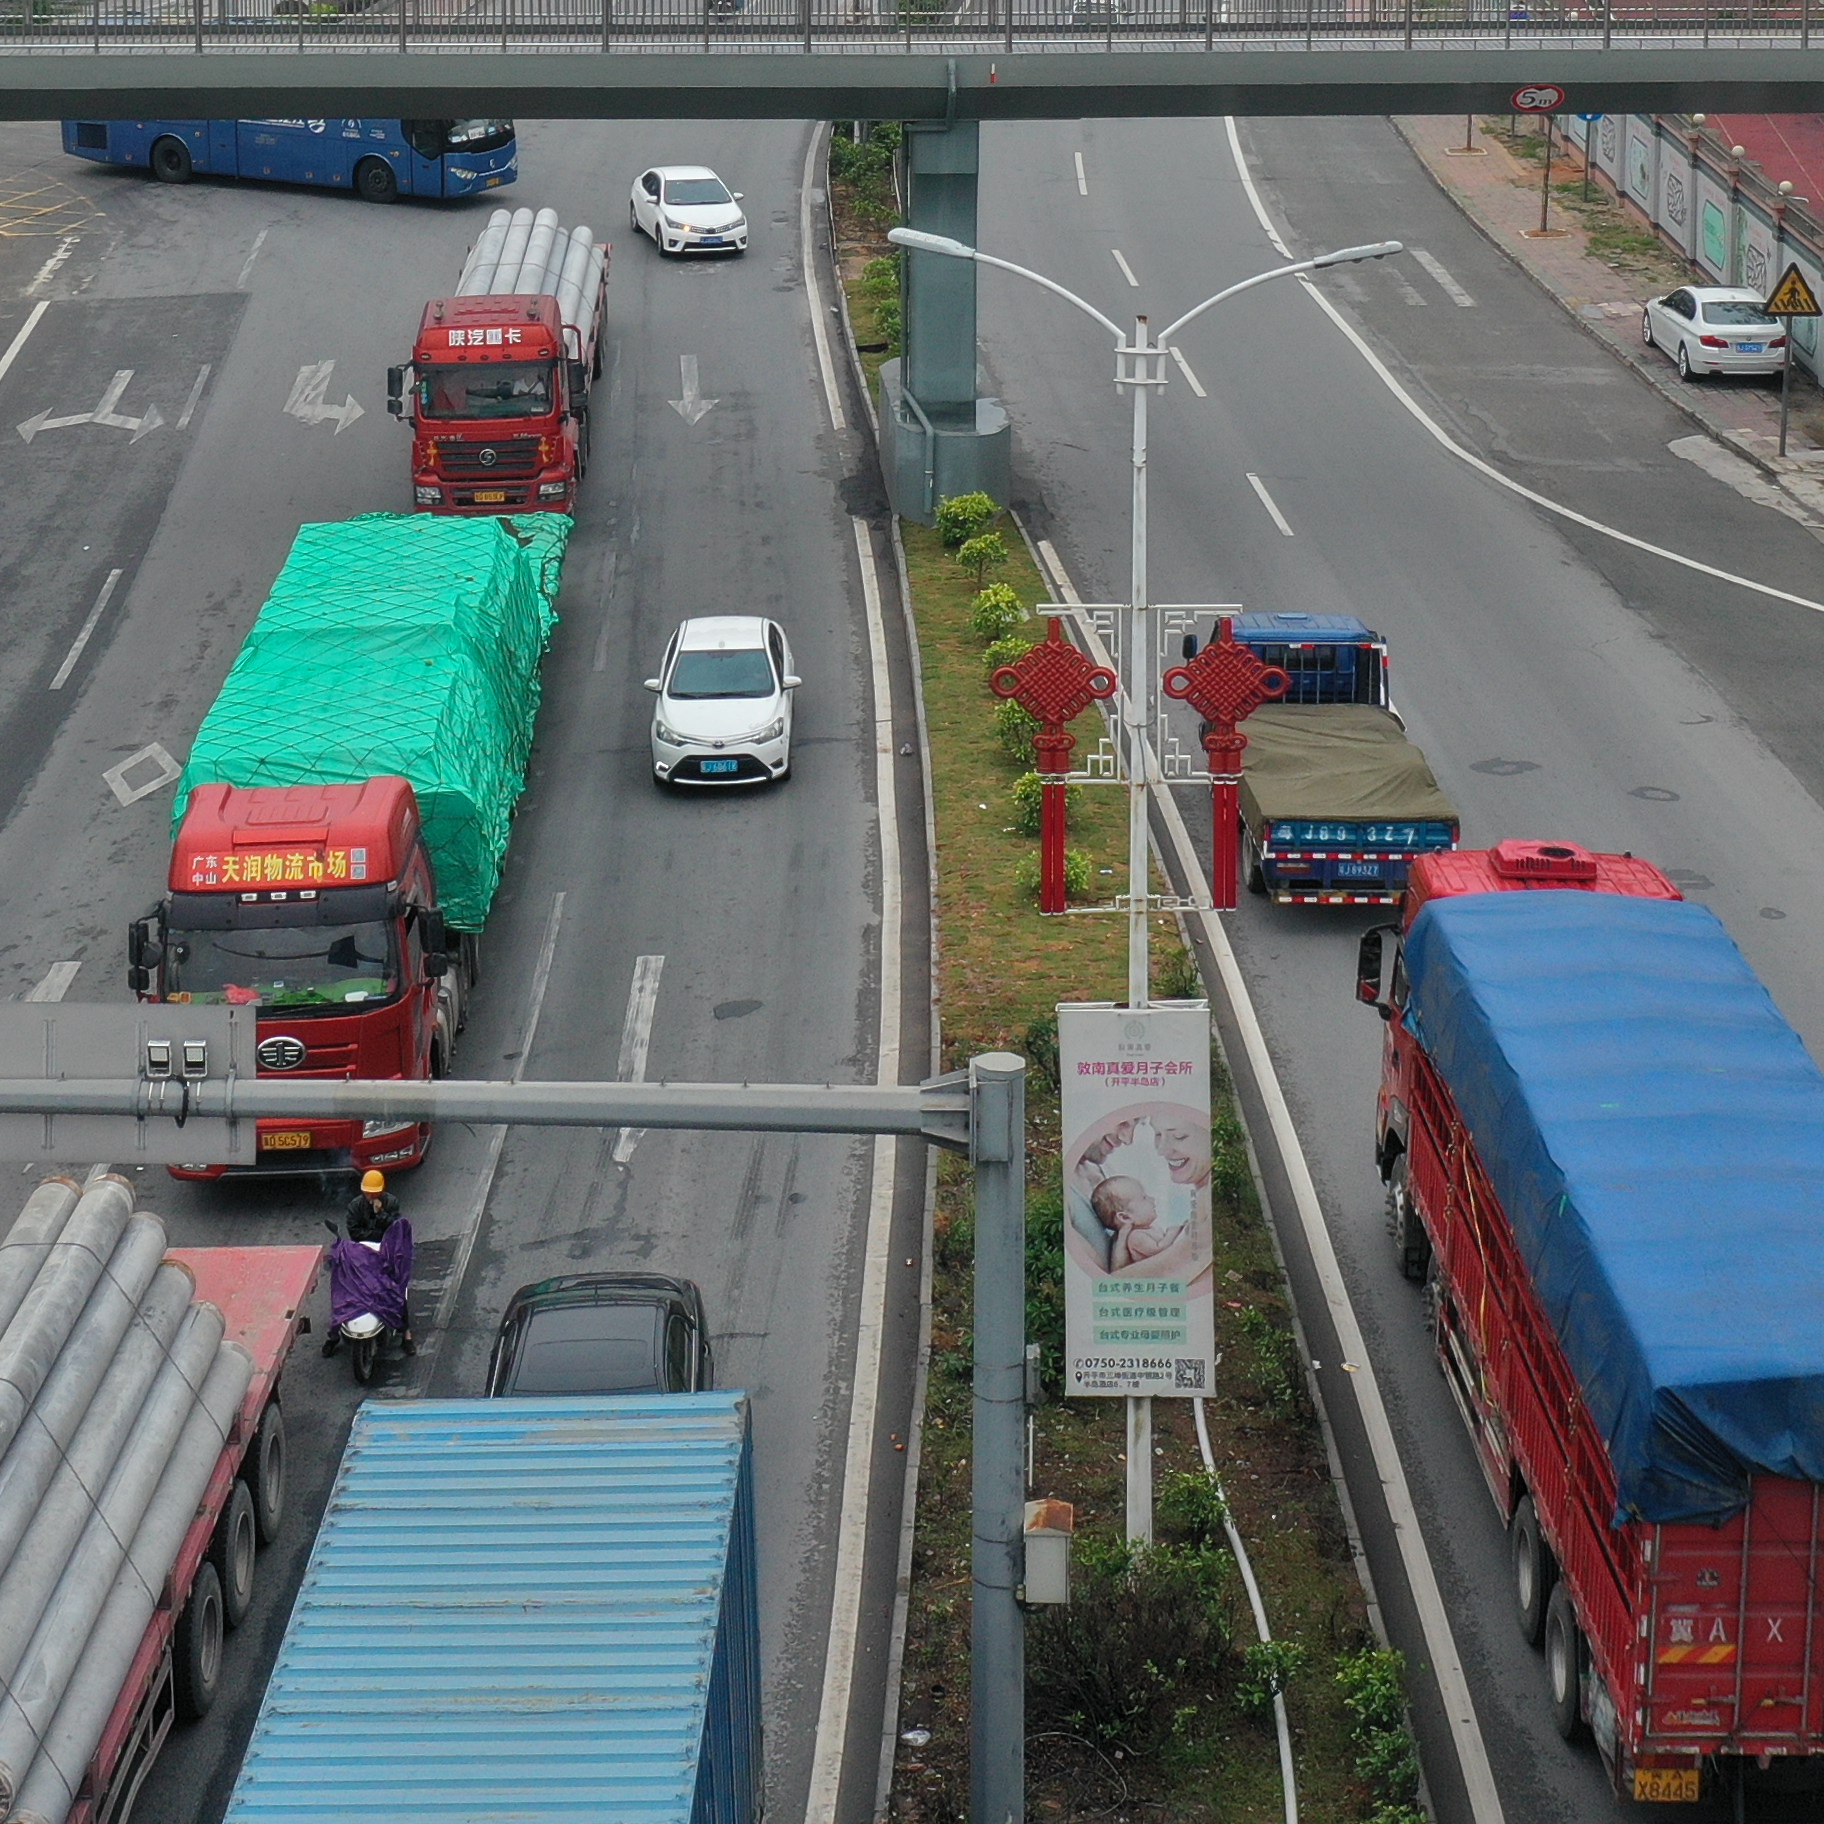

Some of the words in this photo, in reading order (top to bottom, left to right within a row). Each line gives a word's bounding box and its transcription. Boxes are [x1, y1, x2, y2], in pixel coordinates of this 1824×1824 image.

[1519, 91, 1537, 106] 5
[449, 328, 521, 347] 陕汽重卡
[192, 855, 218, 870] 广东
[222, 850, 347, 883] 天润物流市场
[192, 871, 217, 886] 中山
[1076, 1061, 1194, 1075] 敦南真爱月子会所
[1098, 1282, 1180, 1293] 台式养生月子餐
[1098, 1307, 1181, 1318] 台式医疗级管理
[1084, 1358, 1173, 1368] 0750-2318666
